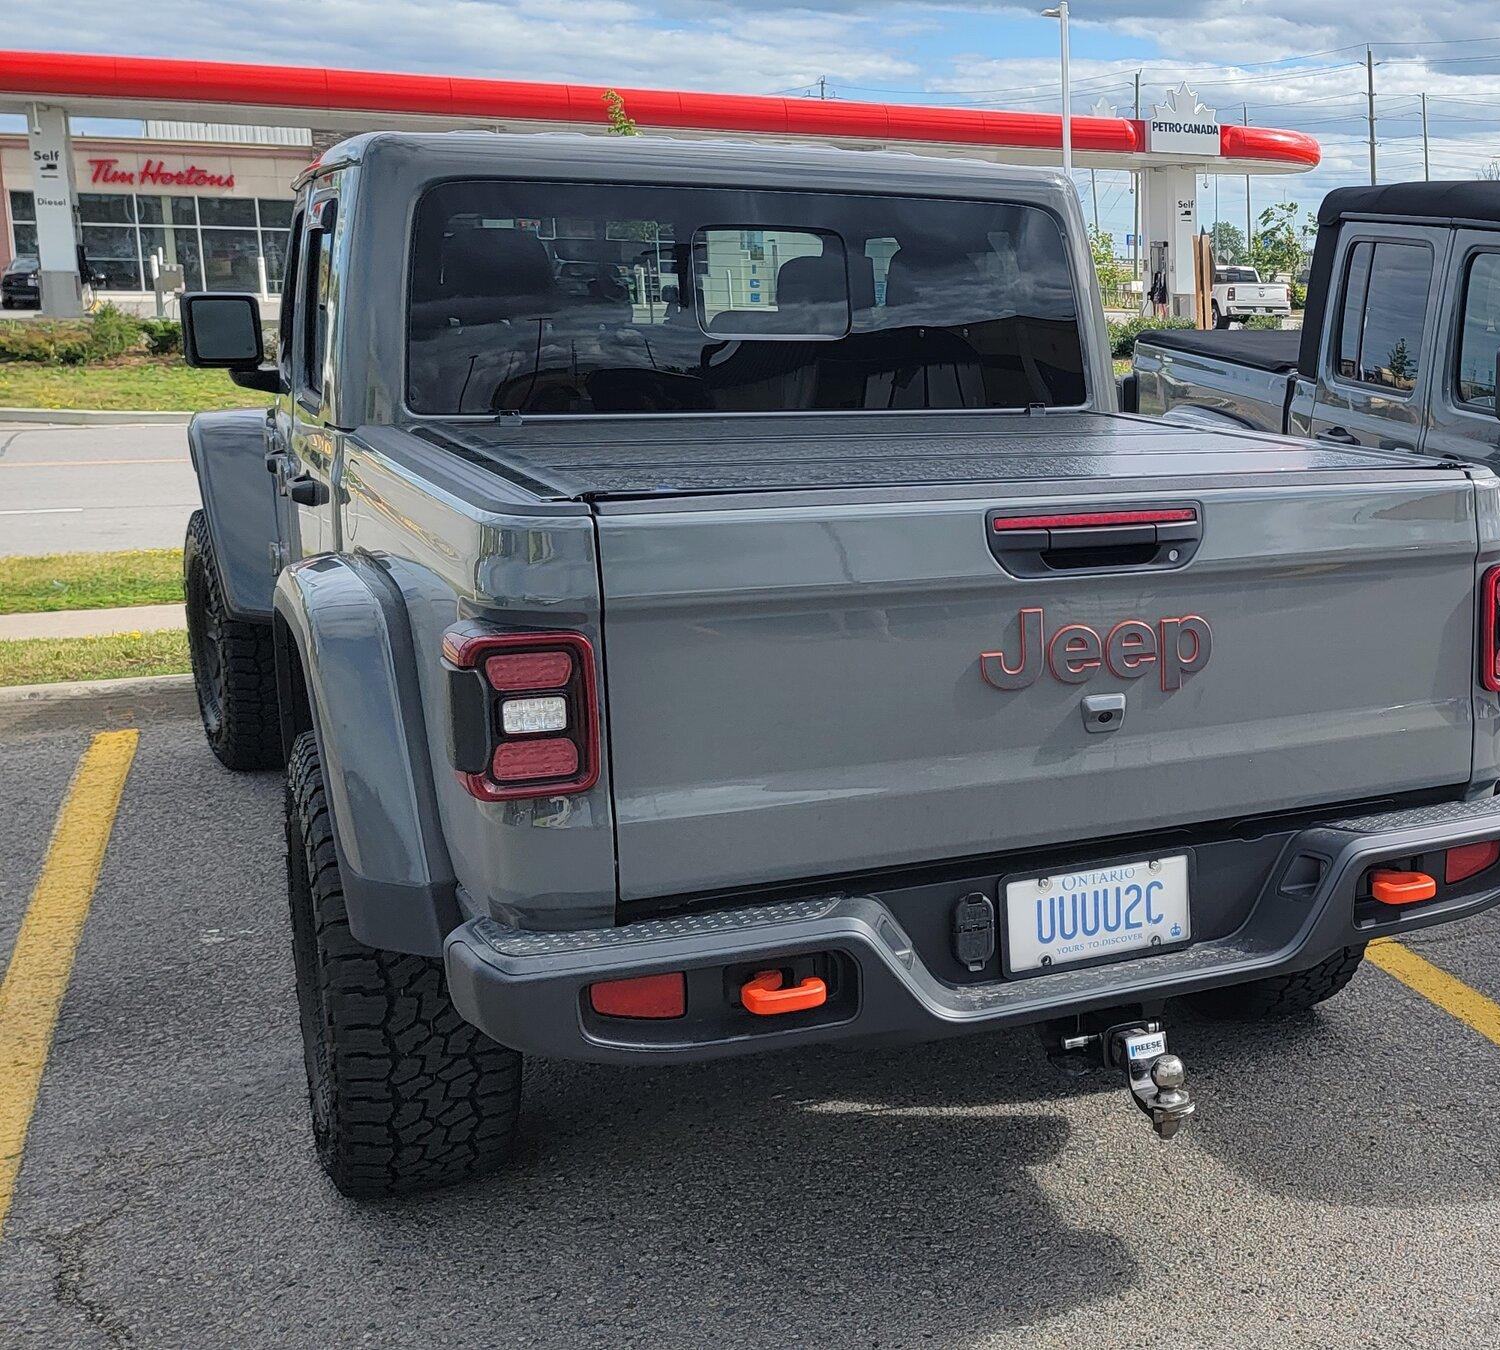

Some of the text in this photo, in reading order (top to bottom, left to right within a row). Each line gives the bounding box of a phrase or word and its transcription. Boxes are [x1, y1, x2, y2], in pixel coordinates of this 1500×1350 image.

[1152, 121, 1219, 135] PETRO-CANADA
[33, 150, 60, 161] Self
[87, 157, 235, 188] Tim Hortons
[37, 198, 67, 206] Diesel
[1178, 200, 1195, 209] Self
[979, 607, 1214, 693] Jeep
[1061, 867, 1136, 891] ONTARIO
[1036, 880, 1164, 944] UUUU2C
[1056, 932, 1144, 955] YOURS TO DISCOVER
[1135, 1040, 1162, 1052] REESE
